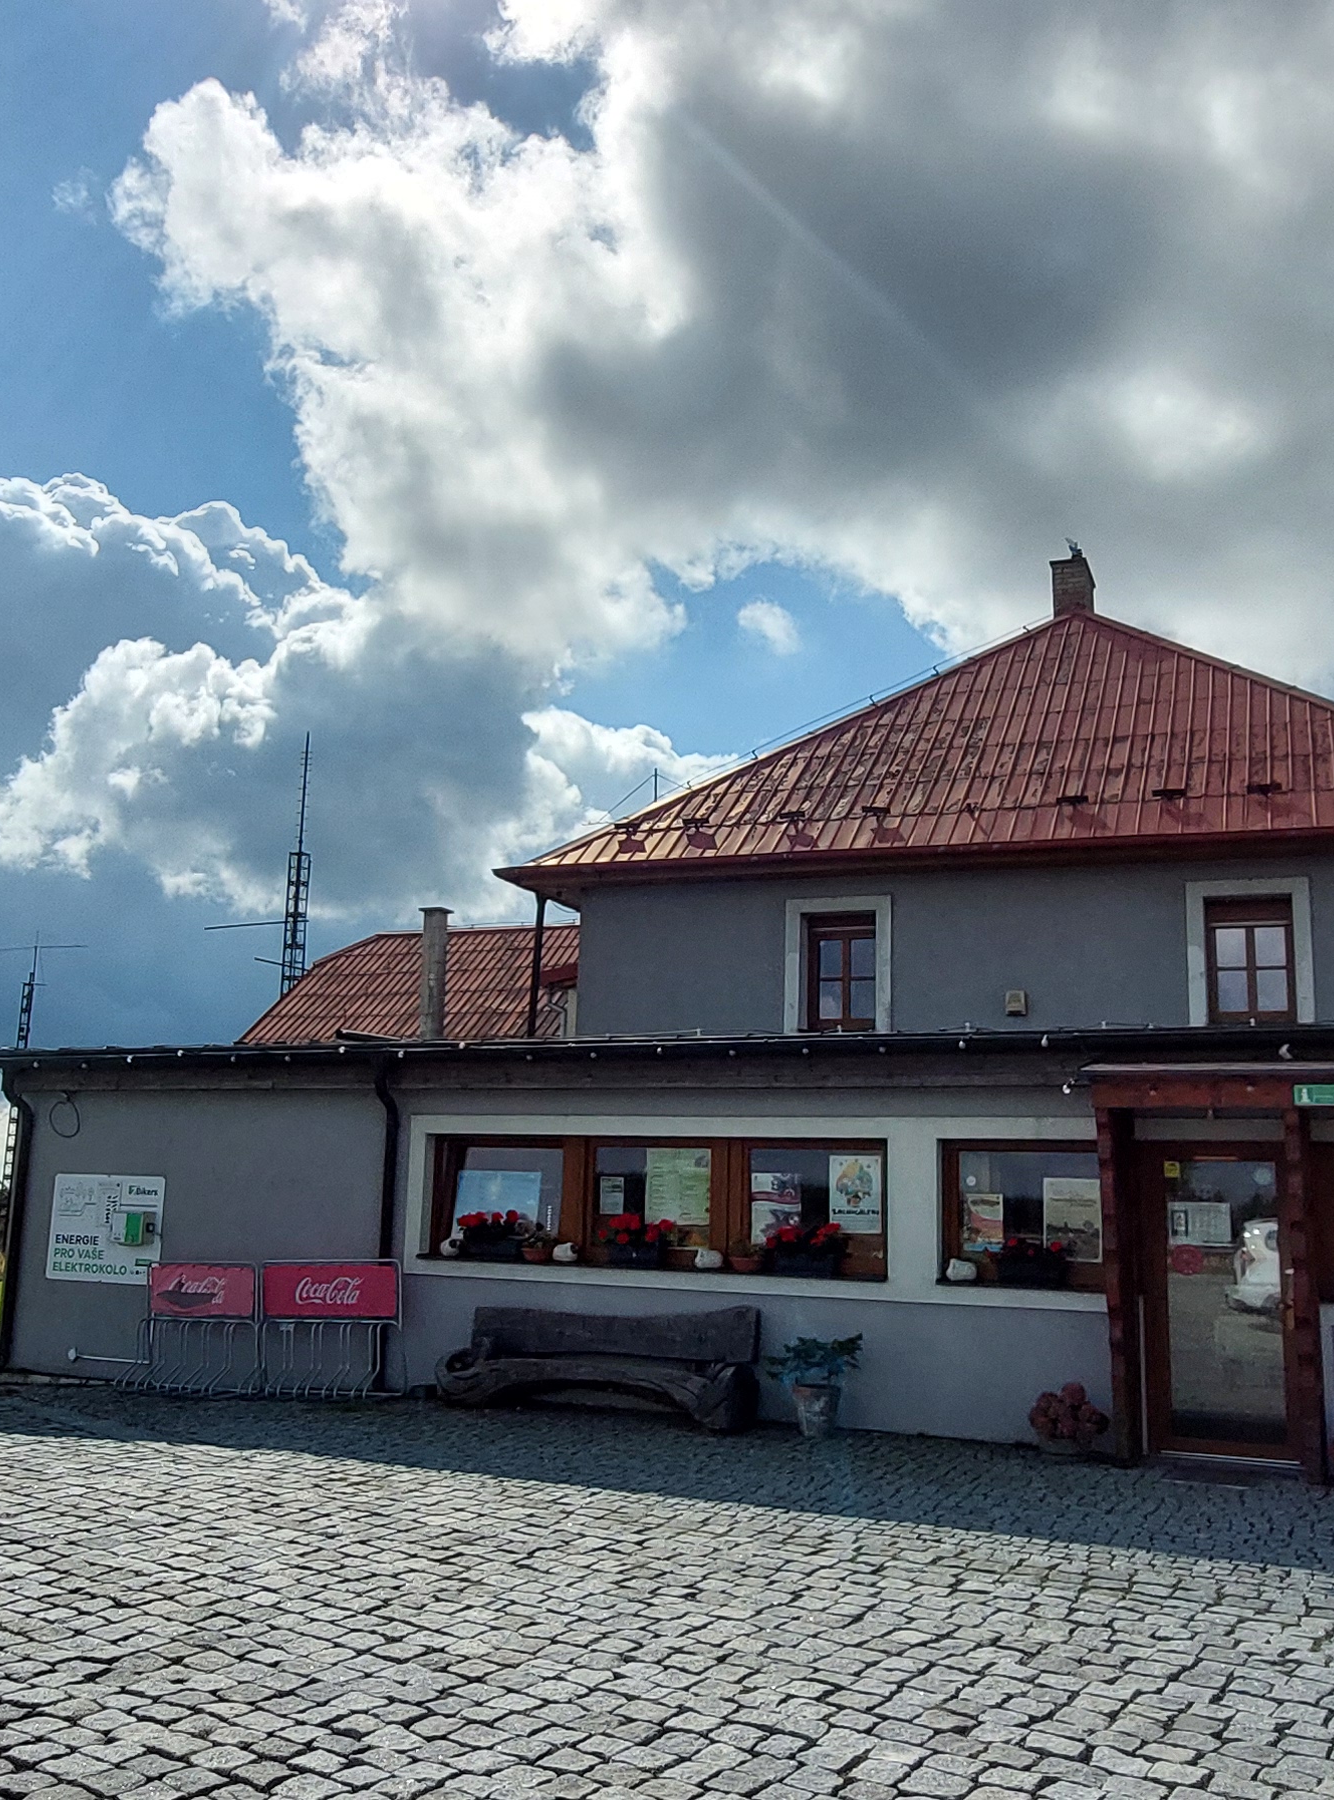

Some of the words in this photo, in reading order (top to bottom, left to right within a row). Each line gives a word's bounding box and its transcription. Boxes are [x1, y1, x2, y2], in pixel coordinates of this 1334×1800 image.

[55, 1233, 100, 1246] ENERGIE
[53, 1247, 75, 1259] PRO
[78, 1246, 105, 1260] VAŠE
[52, 1261, 127, 1276] ELEKTROKOLO
